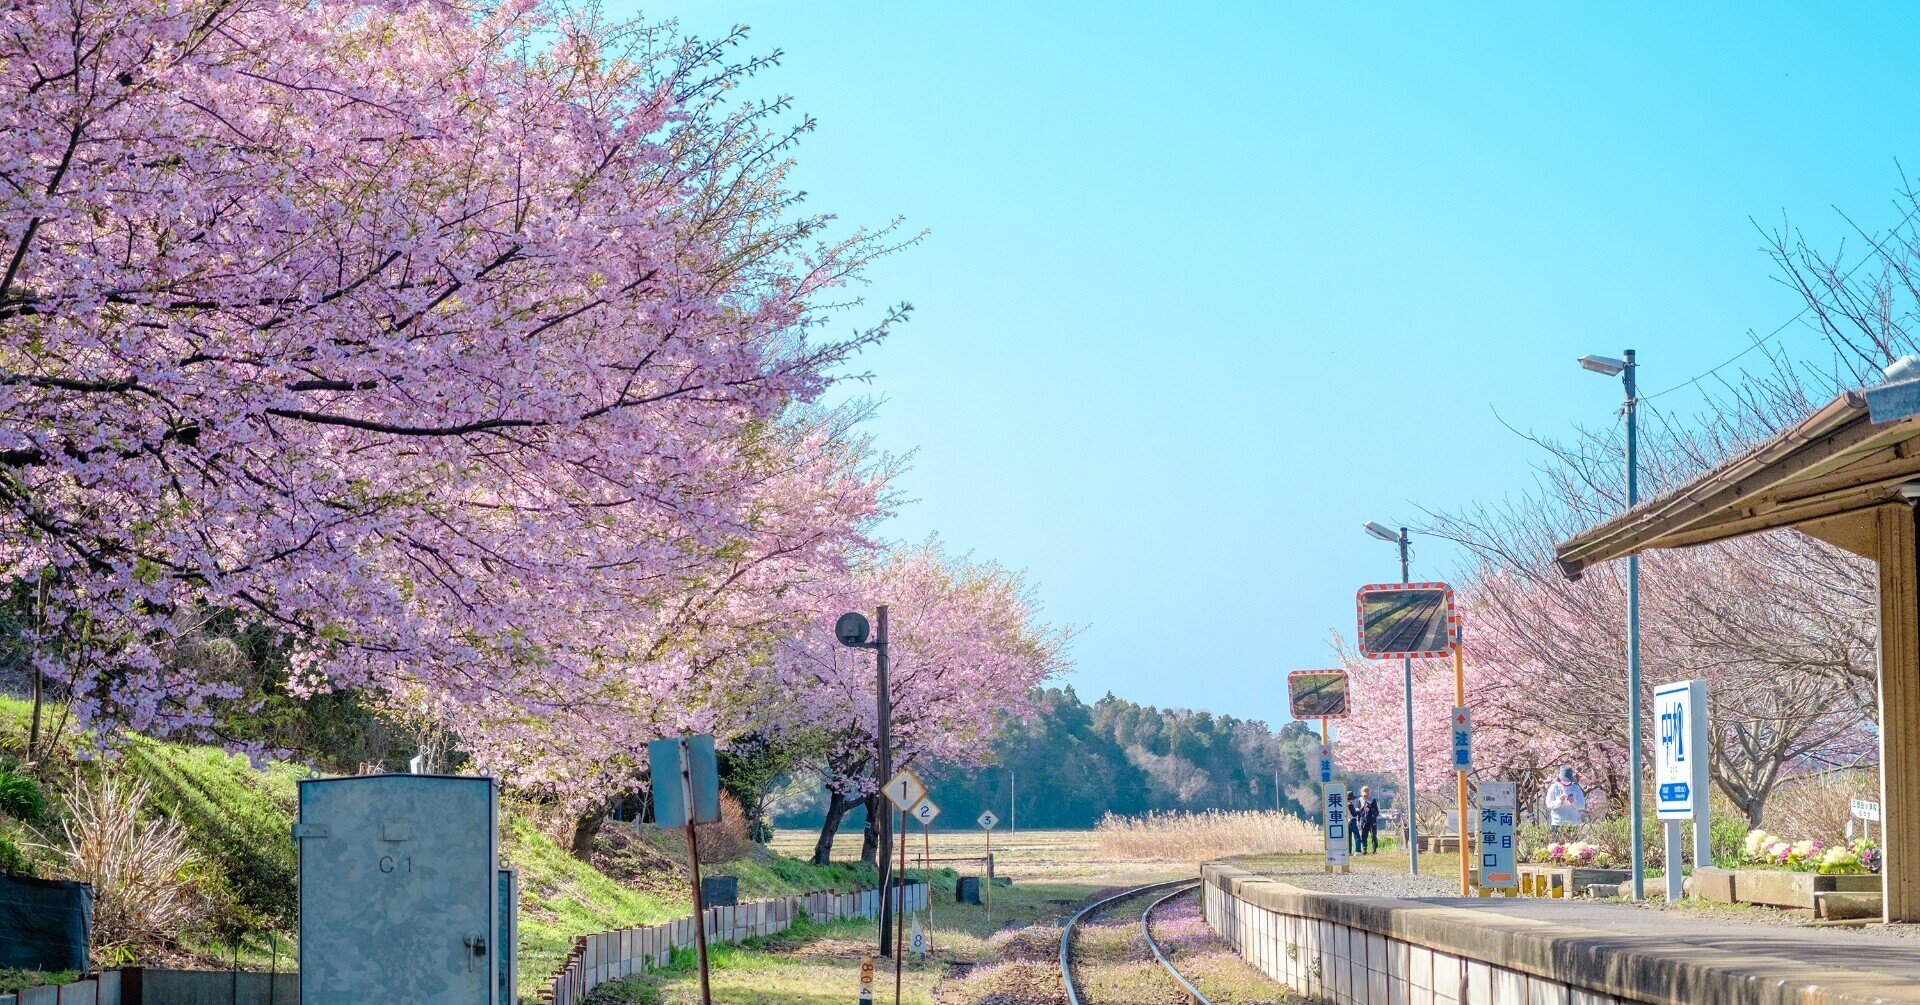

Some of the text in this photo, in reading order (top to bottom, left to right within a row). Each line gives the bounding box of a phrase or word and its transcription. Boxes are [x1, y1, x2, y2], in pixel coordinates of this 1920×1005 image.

[1455, 730, 1470, 765] 注意
[901, 780, 907, 800] 1
[920, 805, 930, 818] 2
[984, 815, 992, 825] 3
[1328, 793, 1344, 839] 乗車口
[1481, 808, 1498, 867] 乗車口
[1499, 812, 1513, 848] 両目
[914, 934, 922, 947] 8
